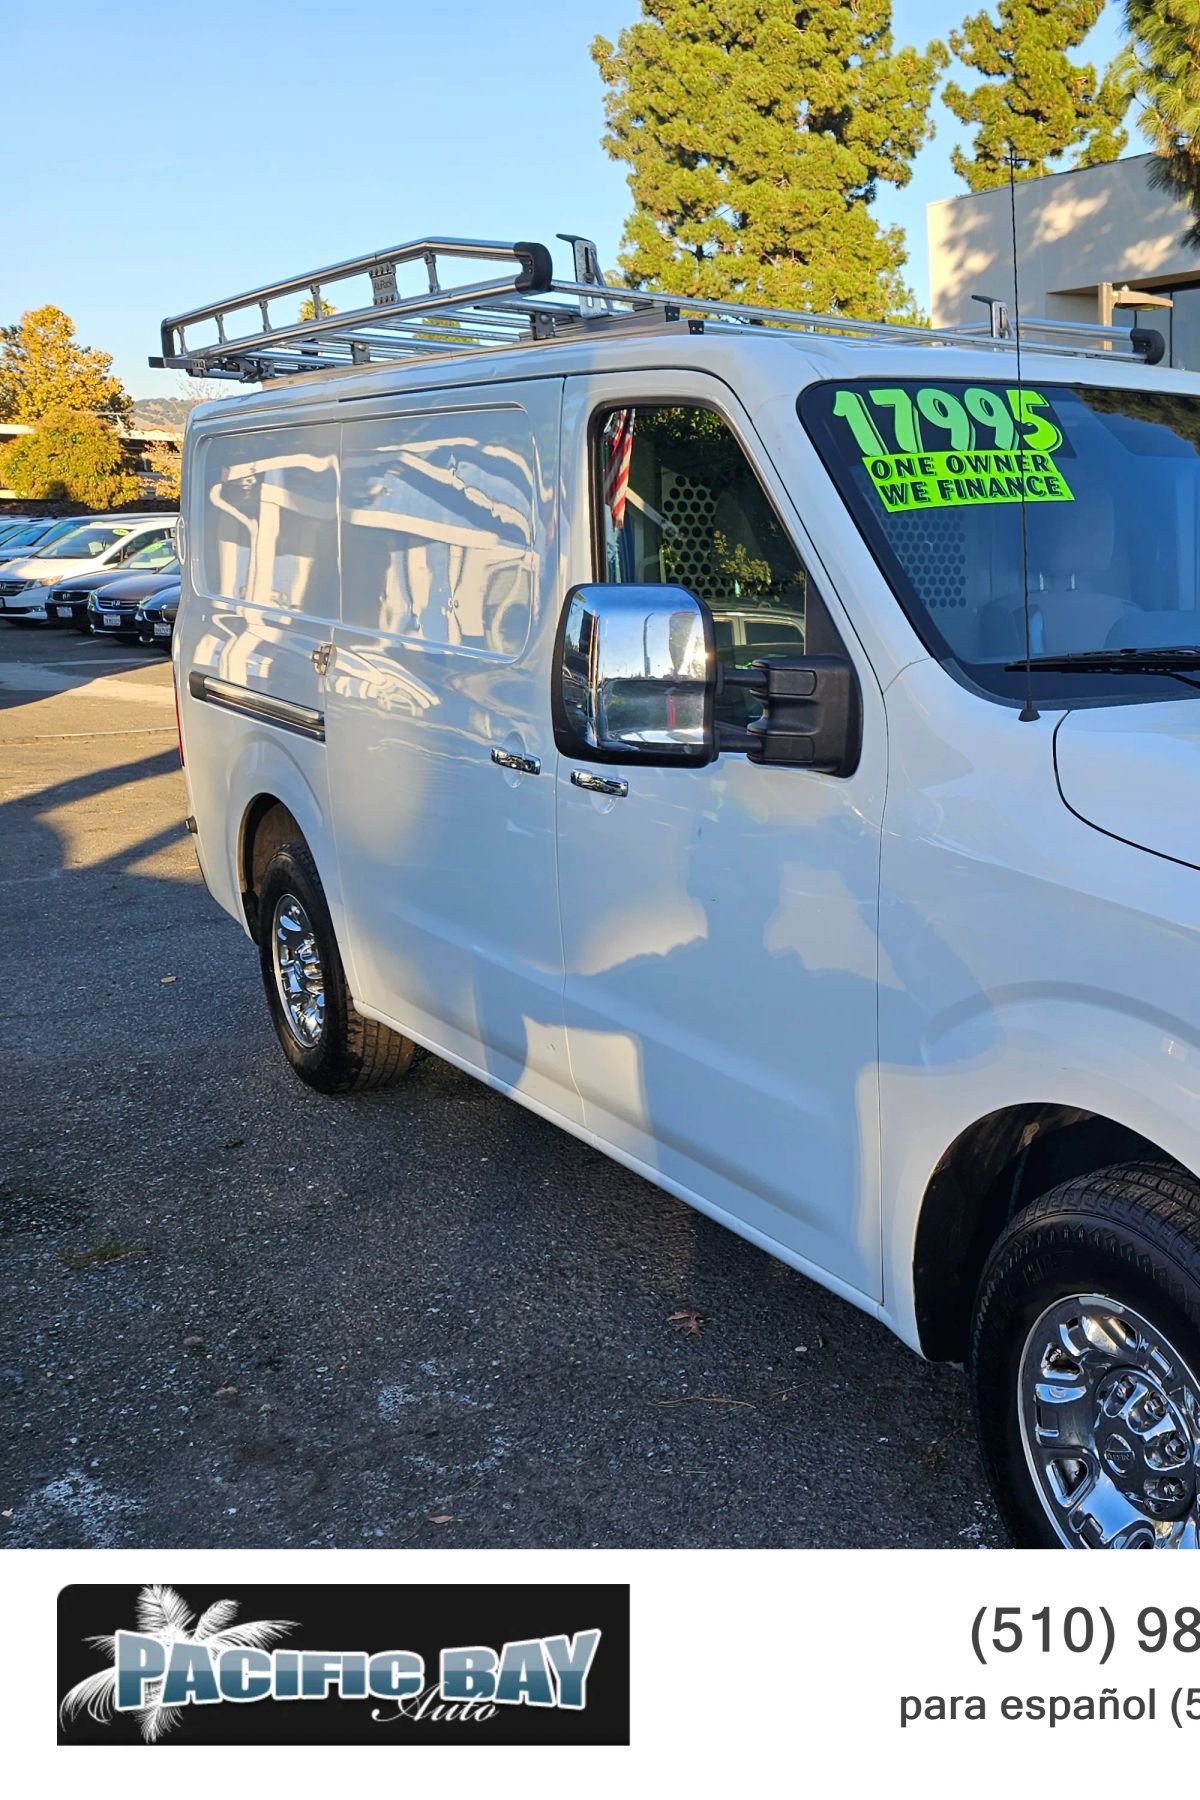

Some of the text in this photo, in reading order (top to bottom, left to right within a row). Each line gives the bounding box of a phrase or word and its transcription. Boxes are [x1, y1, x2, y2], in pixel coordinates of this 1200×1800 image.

[833, 388, 1063, 456] 17995
[871, 454, 1050, 479] ONE OWNER
[879, 475, 1062, 506] WE FINANCE
